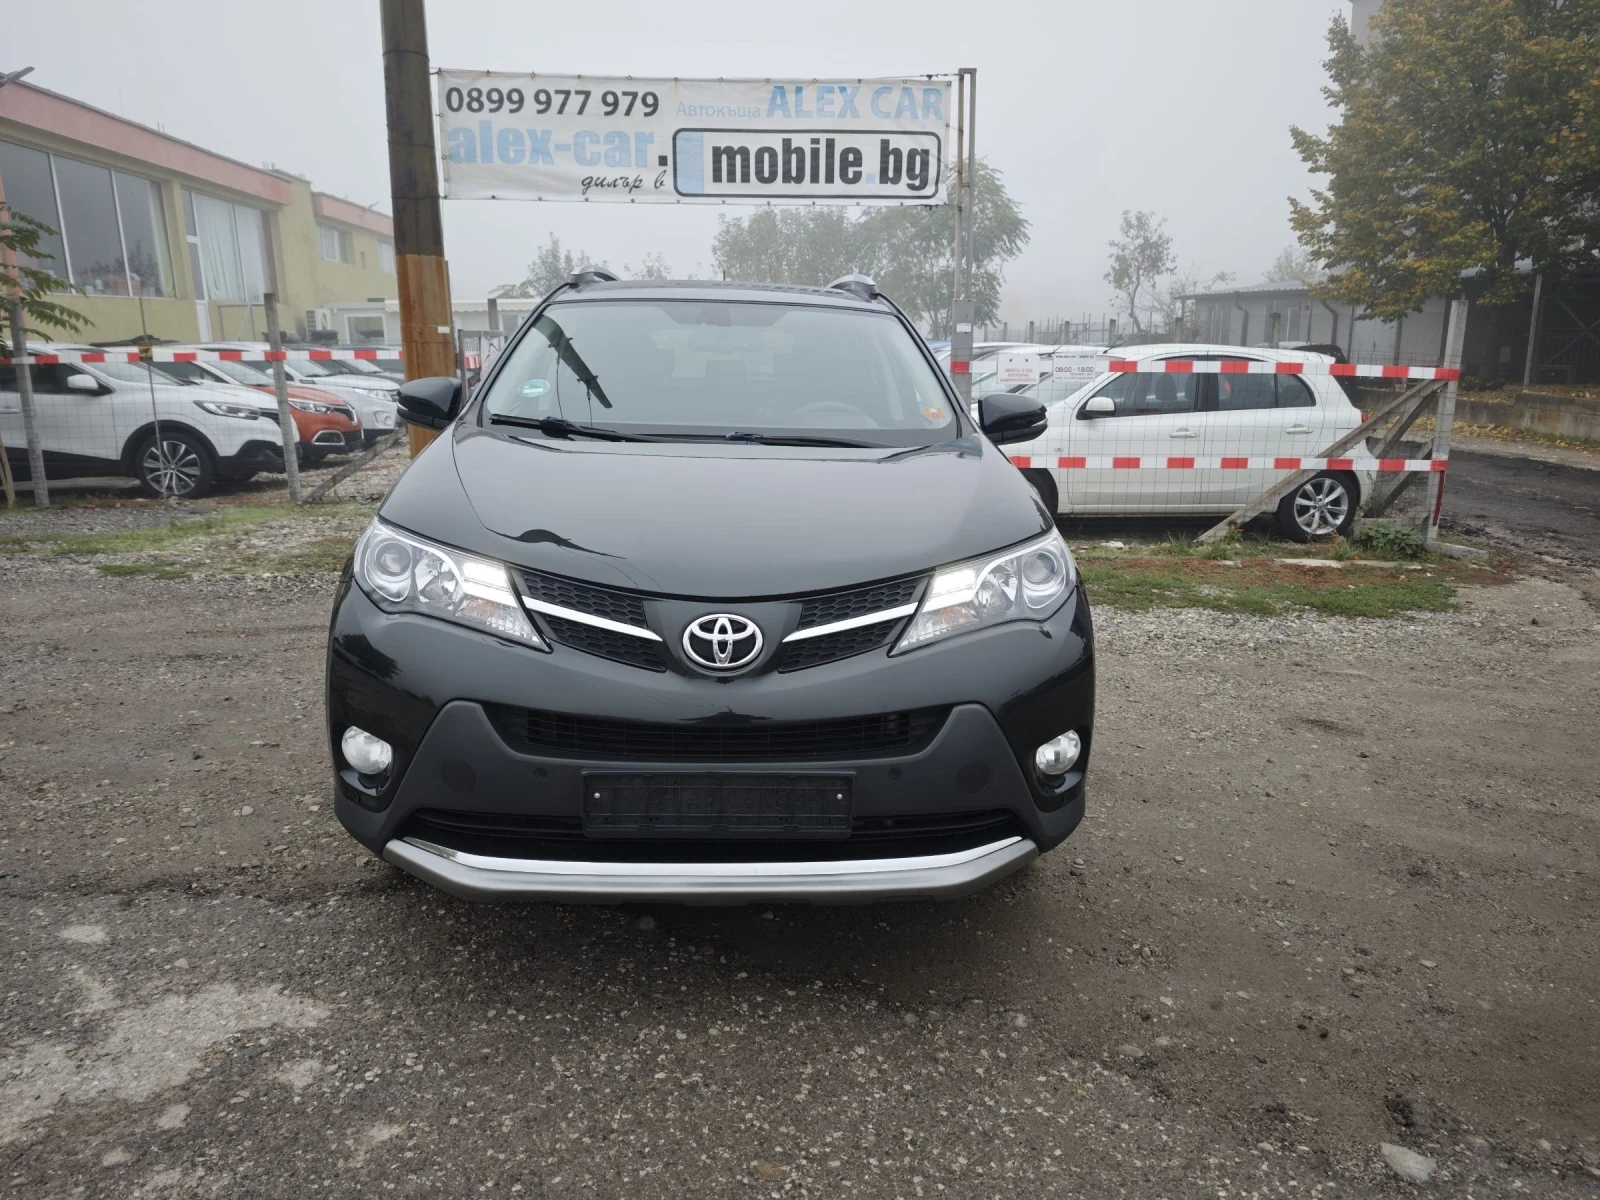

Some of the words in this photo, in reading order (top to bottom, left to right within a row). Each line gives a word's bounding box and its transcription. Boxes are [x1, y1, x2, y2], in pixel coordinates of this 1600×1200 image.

[446, 87, 525, 114] 0899
[533, 88, 592, 116] 977
[601, 90, 660, 118] 979
[675, 101, 761, 119] Автокъща
[766, 85, 861, 119] ALEX
[870, 86, 943, 121] CAR
[711, 137, 930, 191] mobile.bg
[581, 174, 645, 196] дилър
